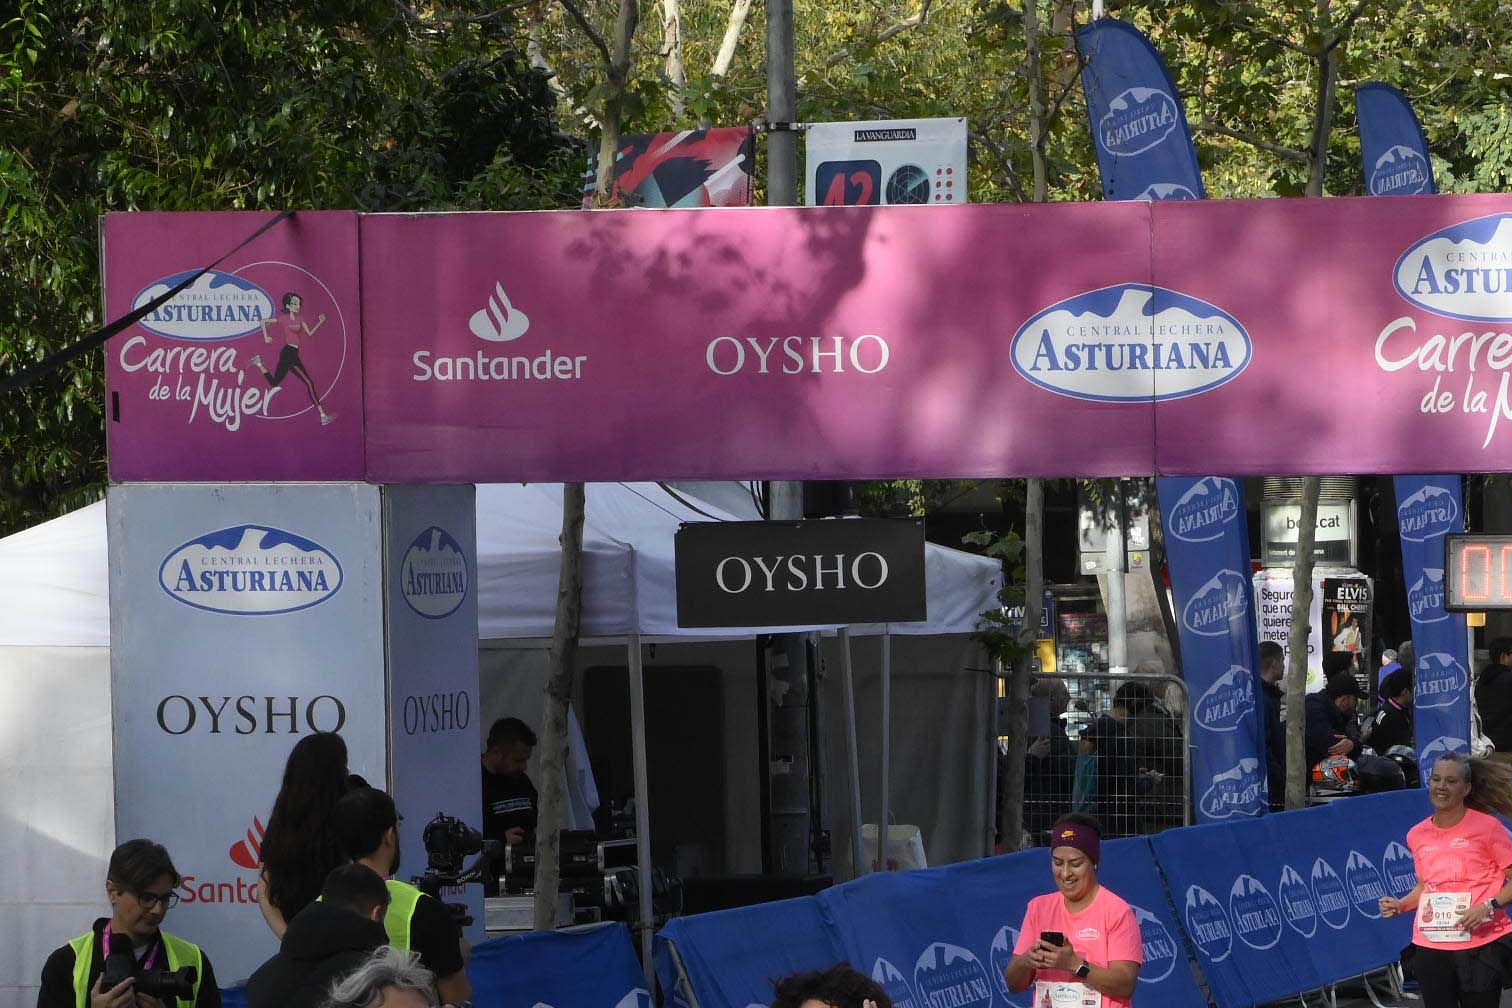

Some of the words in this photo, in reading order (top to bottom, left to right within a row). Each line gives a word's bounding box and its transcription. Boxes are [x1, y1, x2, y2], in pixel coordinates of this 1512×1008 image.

[866, 129, 916, 141] VANGUARDIA
[172, 292, 209, 302] ENTRAL
[1065, 325, 1142, 337] CENTRAL
[1149, 324, 1225, 336] LECHERA
[119, 335, 238, 374] Carrera
[412, 349, 588, 382] Santander
[705, 334, 891, 376] OYSHO
[1028, 328, 1234, 372] ASTURIANA
[148, 374, 171, 401] de
[175, 374, 192, 401] la
[188, 369, 283, 432] Mujer
[1420, 374, 1455, 414] de
[1462, 373, 1488, 414] la
[173, 558, 330, 592] ASTURIANA
[200, 555, 258, 566] CENTRAL
[265, 555, 324, 566] LECHERA
[406, 560, 465, 596] ASTURIANA
[715, 551, 890, 594] OYSHO
[1262, 604, 1279, 616] que
[1337, 587, 1368, 601] ELVIS
[155, 694, 347, 736] OYSHO
[403, 690, 470, 736] OYSHO
[180, 875, 260, 904] Santa
